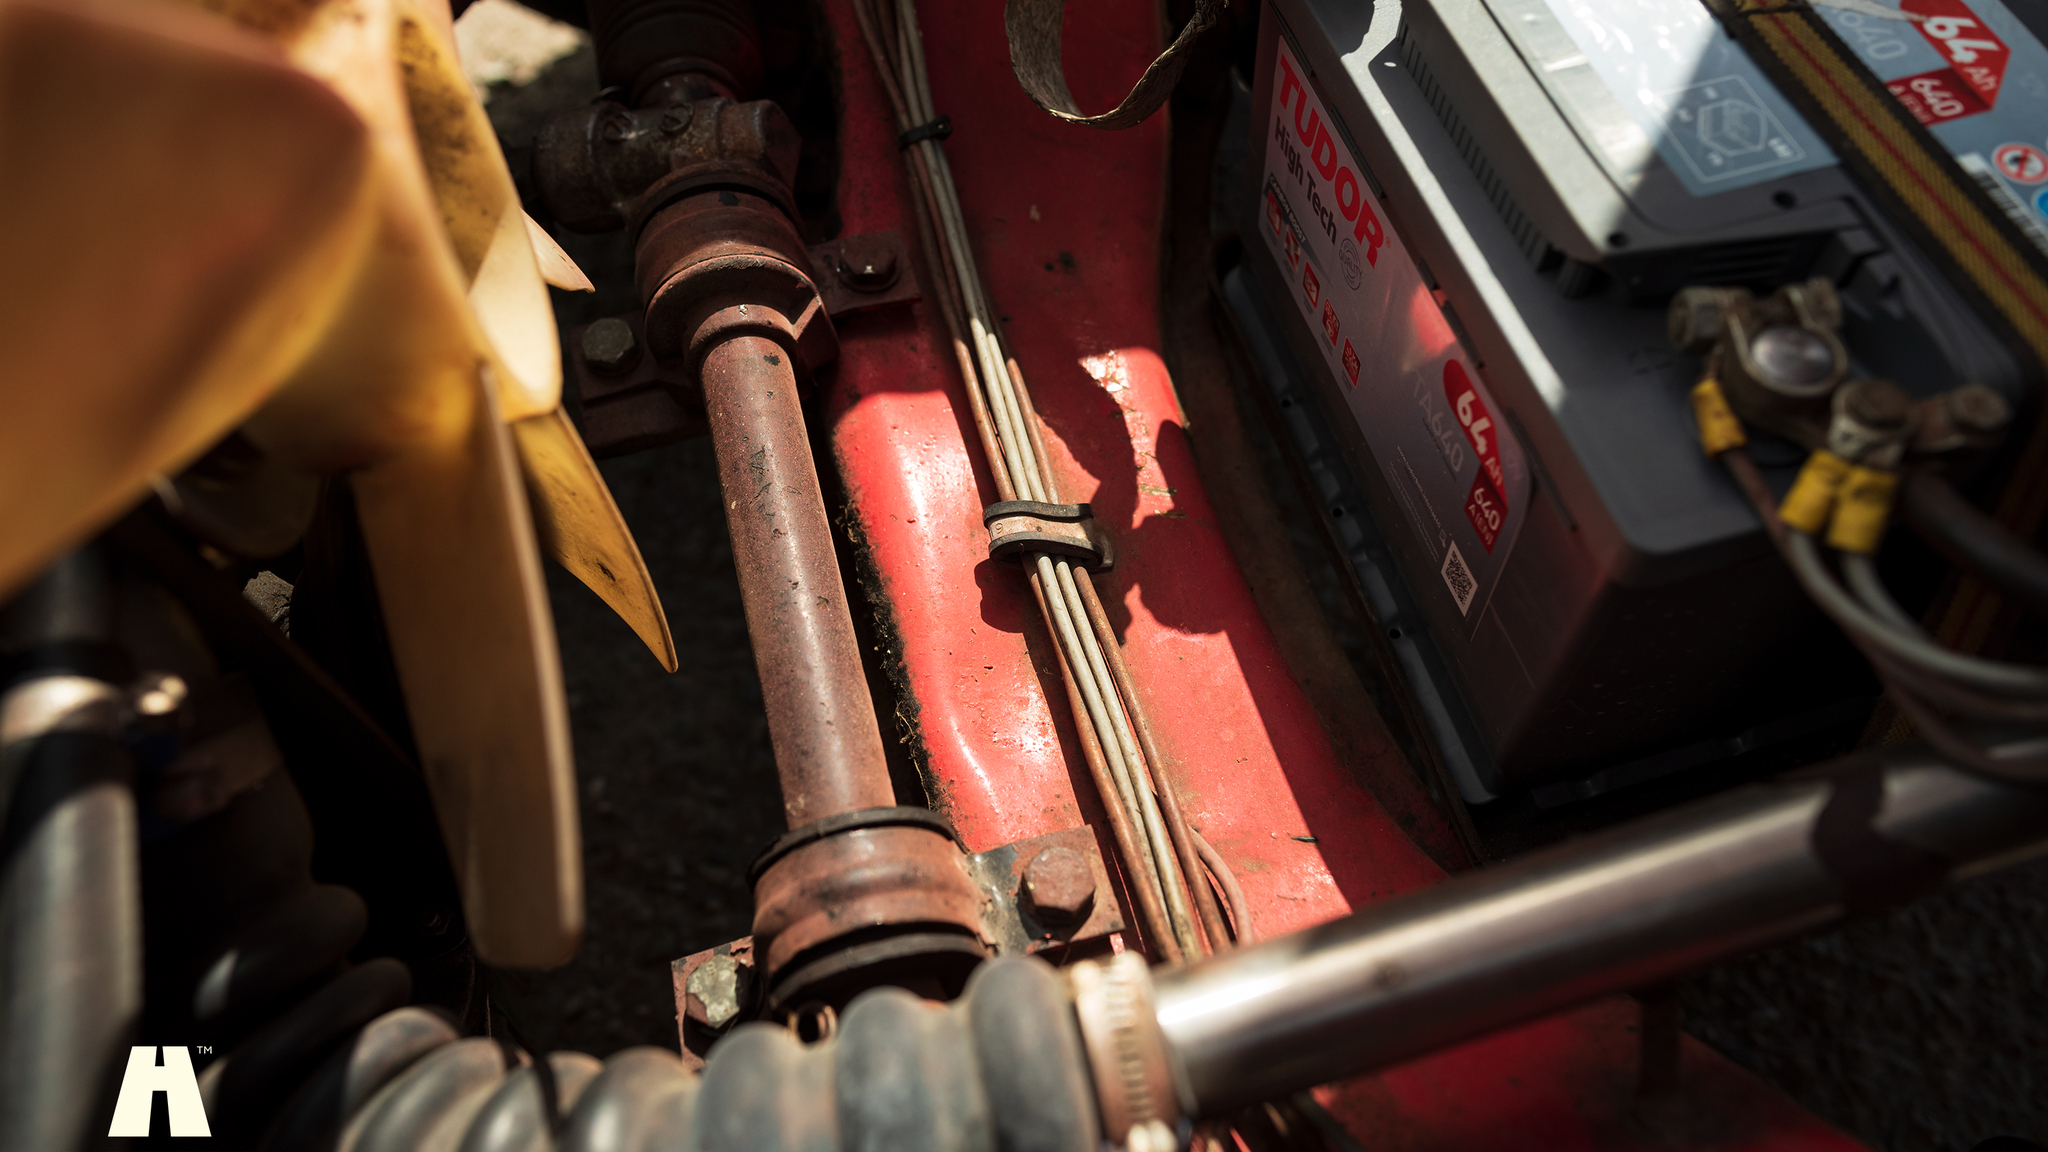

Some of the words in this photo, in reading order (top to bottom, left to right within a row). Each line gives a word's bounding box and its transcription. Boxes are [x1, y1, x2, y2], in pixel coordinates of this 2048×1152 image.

[1924, 15, 2000, 64] 64
[1910, 78, 1965, 117] 640
[1274, 115, 1304, 186] High
[1305, 170, 1337, 246] Tech
[1280, 53, 1384, 269] TUDOR
[1287, 208, 1307, 244] BOOST
[1413, 370, 1464, 472] TA640
[1456, 390, 1491, 455] 64
[1474, 487, 1500, 531] 640
